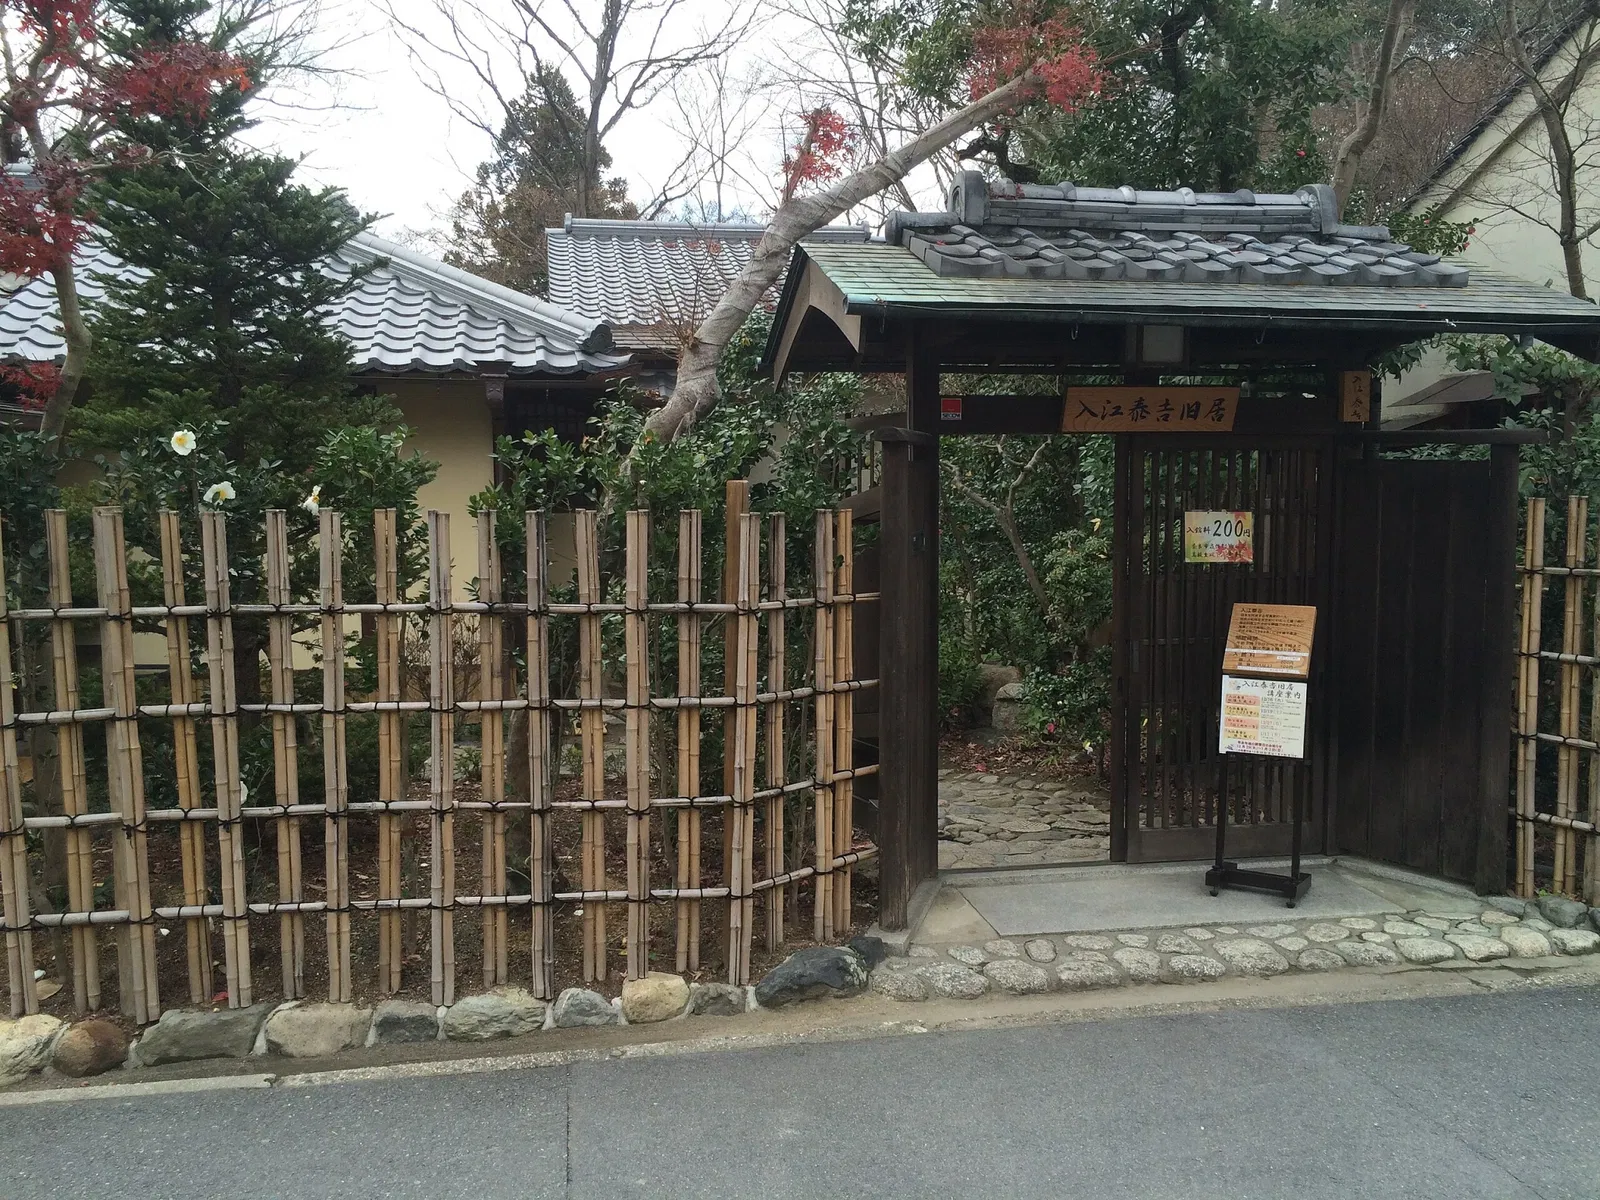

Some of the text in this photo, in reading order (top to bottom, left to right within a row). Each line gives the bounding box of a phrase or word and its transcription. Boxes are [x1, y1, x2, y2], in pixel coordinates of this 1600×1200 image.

[1075, 396, 1227, 423] 入江泰吉旧居
